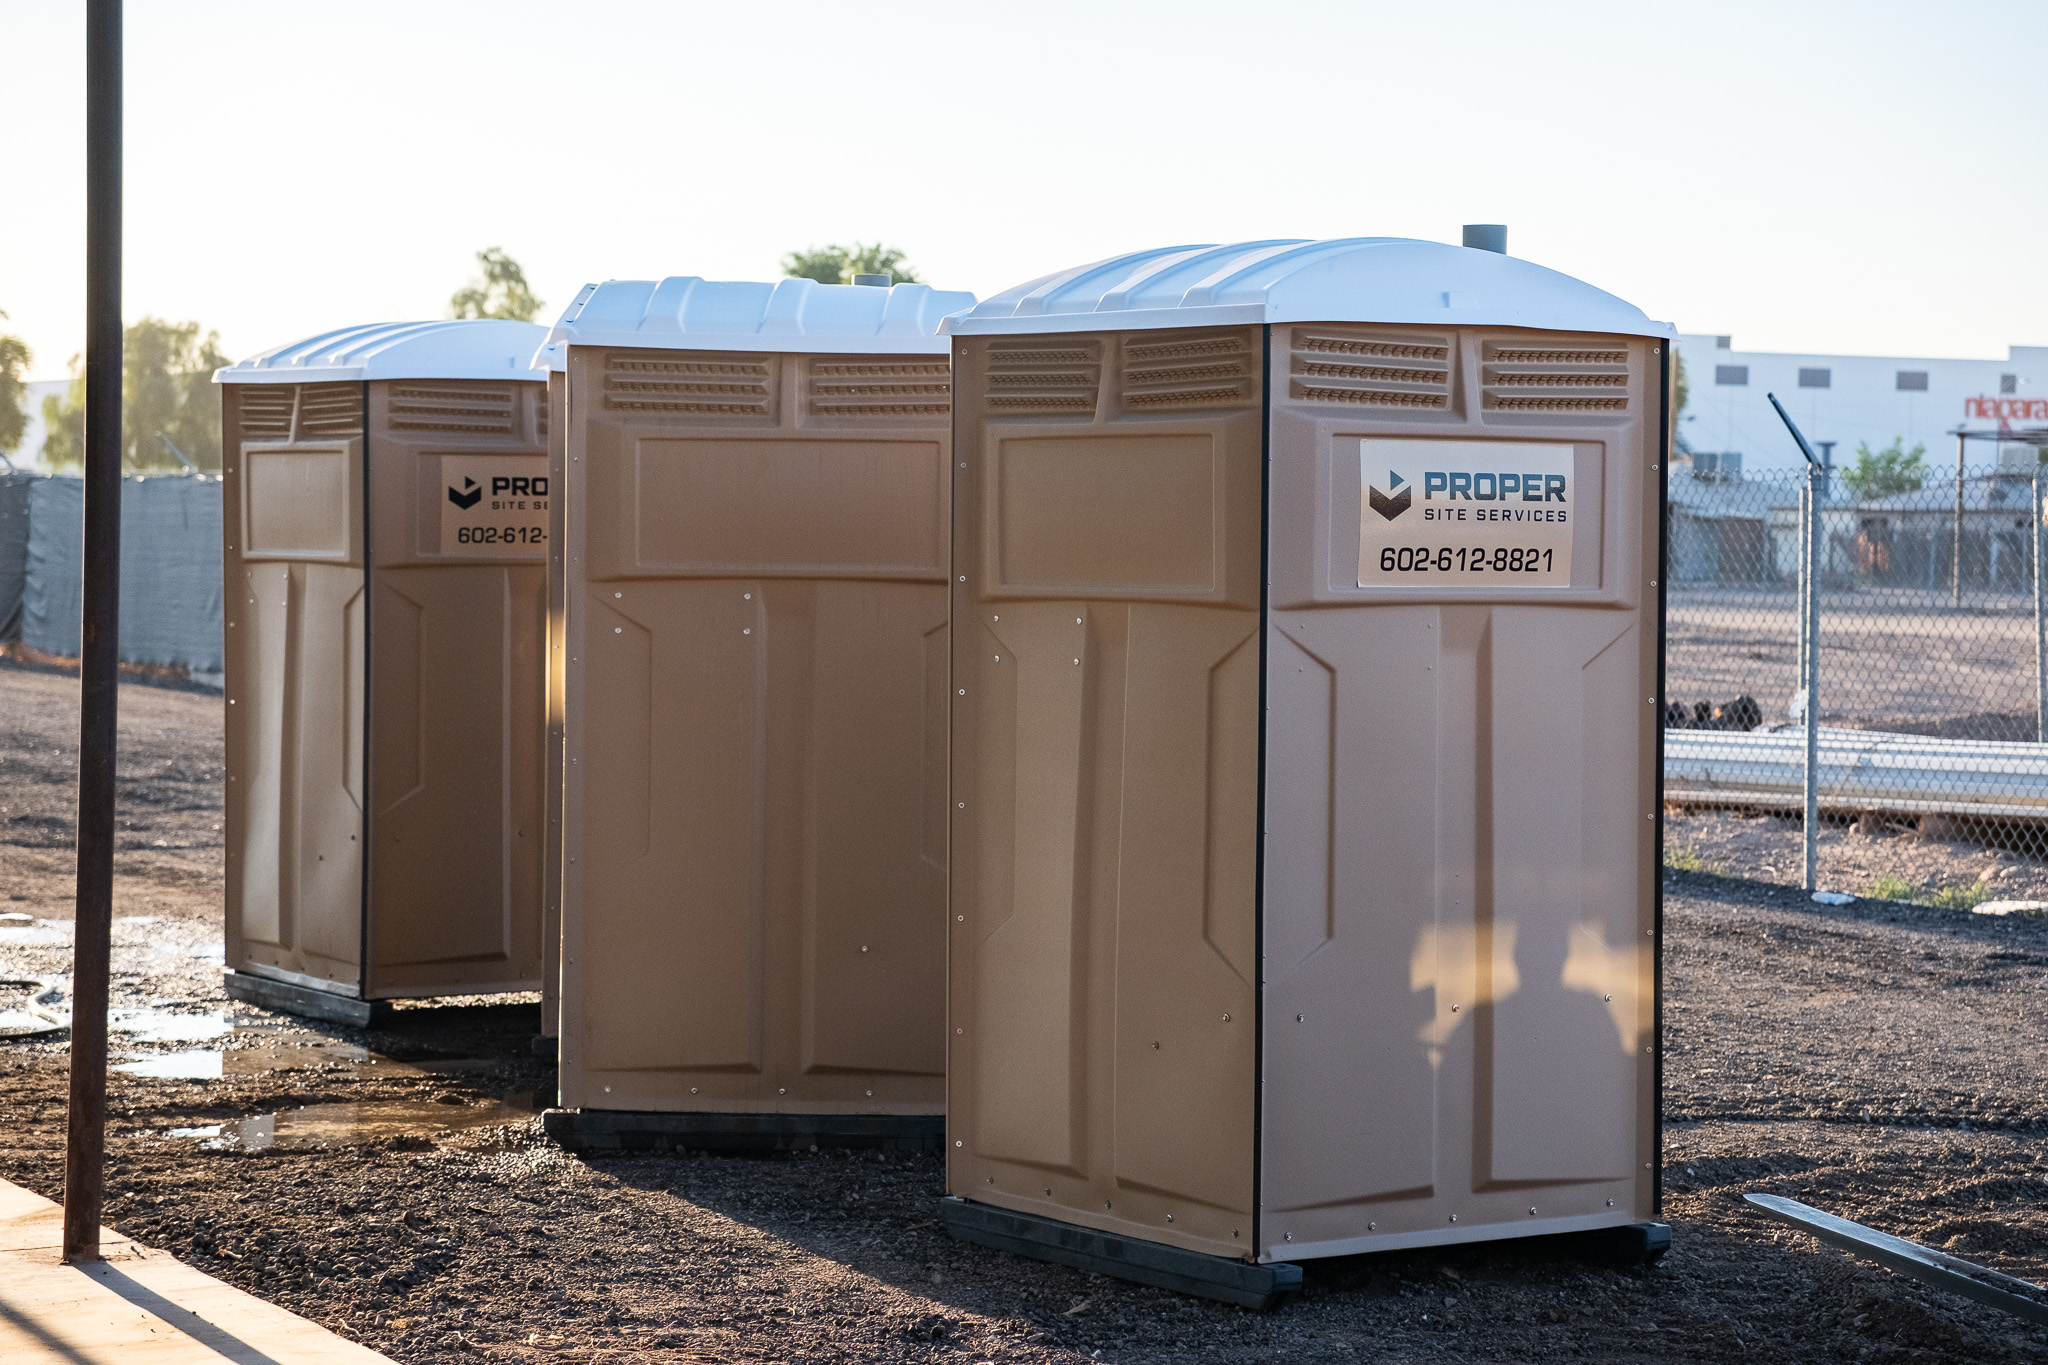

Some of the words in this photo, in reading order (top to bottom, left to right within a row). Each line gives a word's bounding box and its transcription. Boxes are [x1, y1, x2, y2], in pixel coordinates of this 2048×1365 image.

[492, 477, 548, 496] PRO
[1424, 471, 1566, 502] PROPER
[492, 501, 525, 510] SITE
[1424, 508, 1467, 520] SITE
[1476, 509, 1567, 522] SERVICES
[1380, 547, 1553, 572] 602-612-8821
